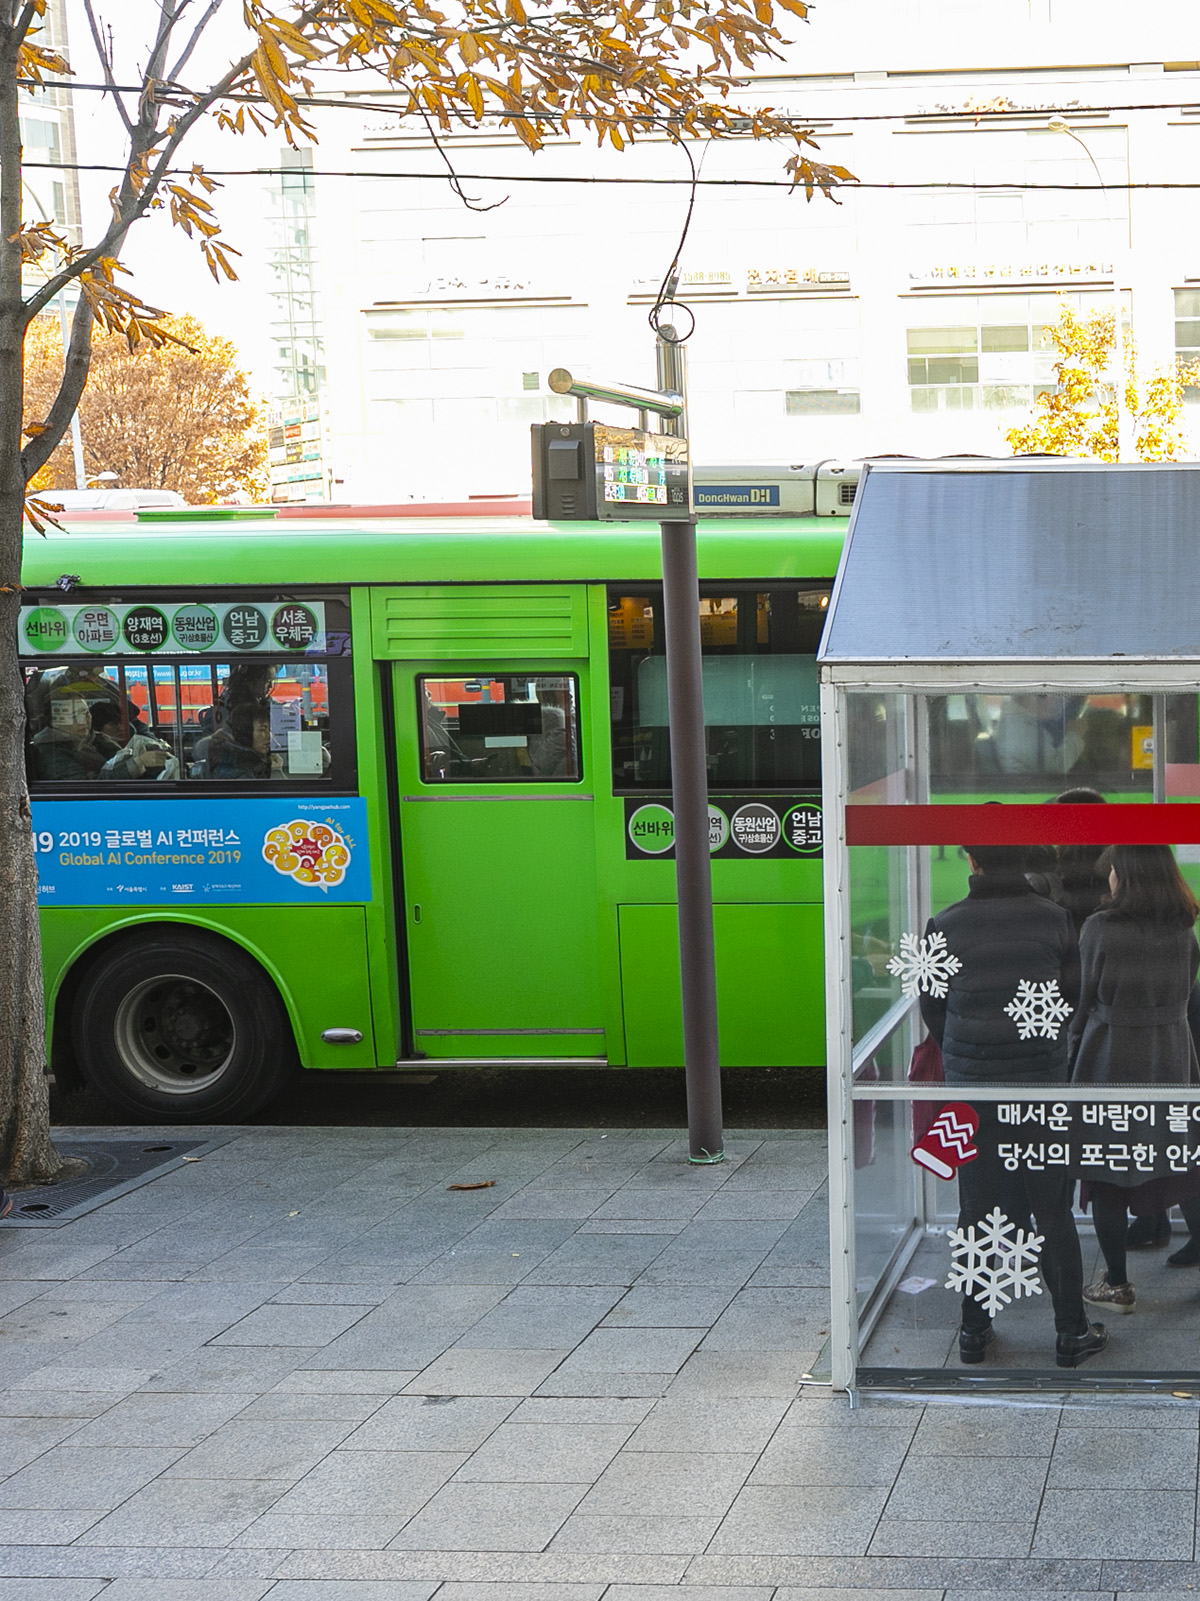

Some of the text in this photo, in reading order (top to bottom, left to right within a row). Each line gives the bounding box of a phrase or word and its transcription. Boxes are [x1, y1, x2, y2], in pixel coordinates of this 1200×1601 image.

[82, 611, 110, 628] 우면
[127, 614, 164, 633] 양재역
[174, 616, 216, 632] 동원산업
[229, 610, 260, 629] 언남
[280, 609, 308, 626] 서초
[25, 620, 67, 638] 선바위
[77, 628, 115, 643] 아파트
[229, 629, 260, 645] 중고
[275, 625, 314, 643] 우체국
[130, 631, 163, 645] (3호선)
[734, 816, 776, 833] 동원산업
[792, 811, 822, 828] 언남
[632, 821, 675, 837] 선바위
[58, 829, 241, 848] 2019 글로벌 AI 컨퍼런스
[738, 833, 774, 844] 구)삼호물산
[58, 850, 241, 866] Global AI Conference 2019
[997, 1103, 1073, 1132] 매서운
[1082, 1104, 1156, 1133] 바람이
[997, 1143, 1071, 1171] 당신의
[1079, 1143, 1158, 1172] 포근한
